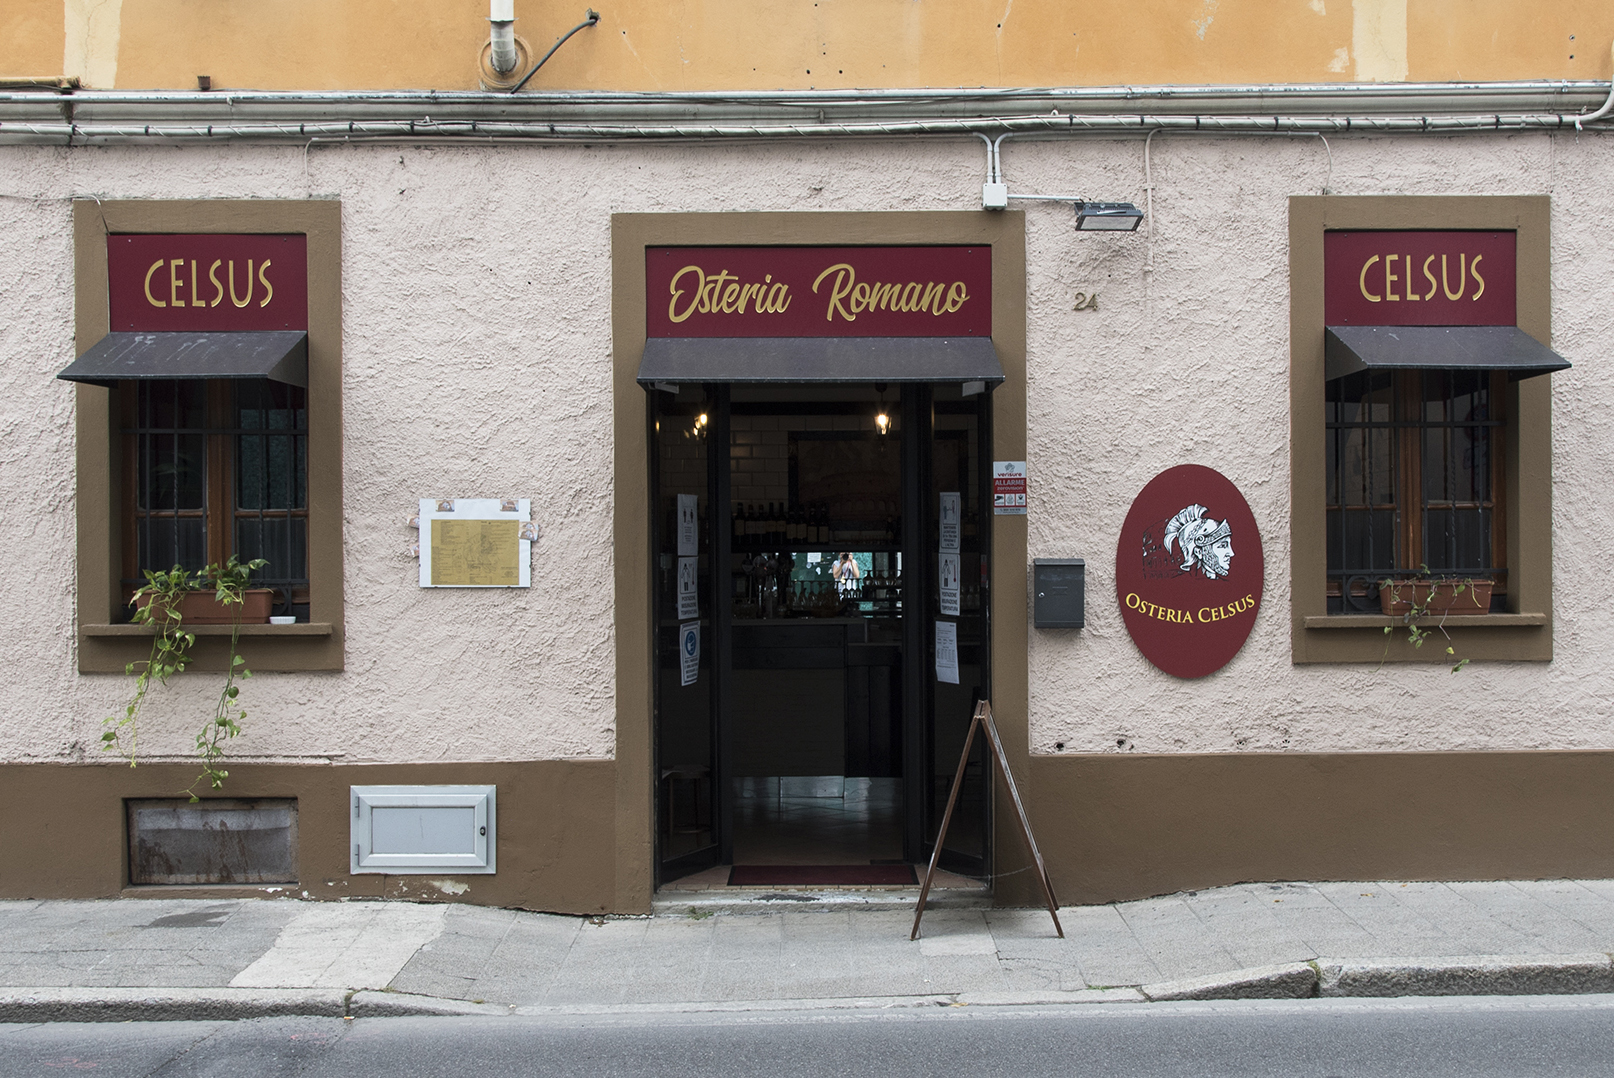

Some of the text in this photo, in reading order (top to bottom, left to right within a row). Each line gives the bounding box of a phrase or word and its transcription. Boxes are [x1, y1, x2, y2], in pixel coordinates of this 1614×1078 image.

[144, 258, 274, 308] CELSUS
[668, 263, 971, 323] Osteria Romano
[1073, 291, 1098, 311] 24
[1359, 253, 1485, 303] CELSUS
[1125, 592, 1256, 624] OSTERIA CELSUS
